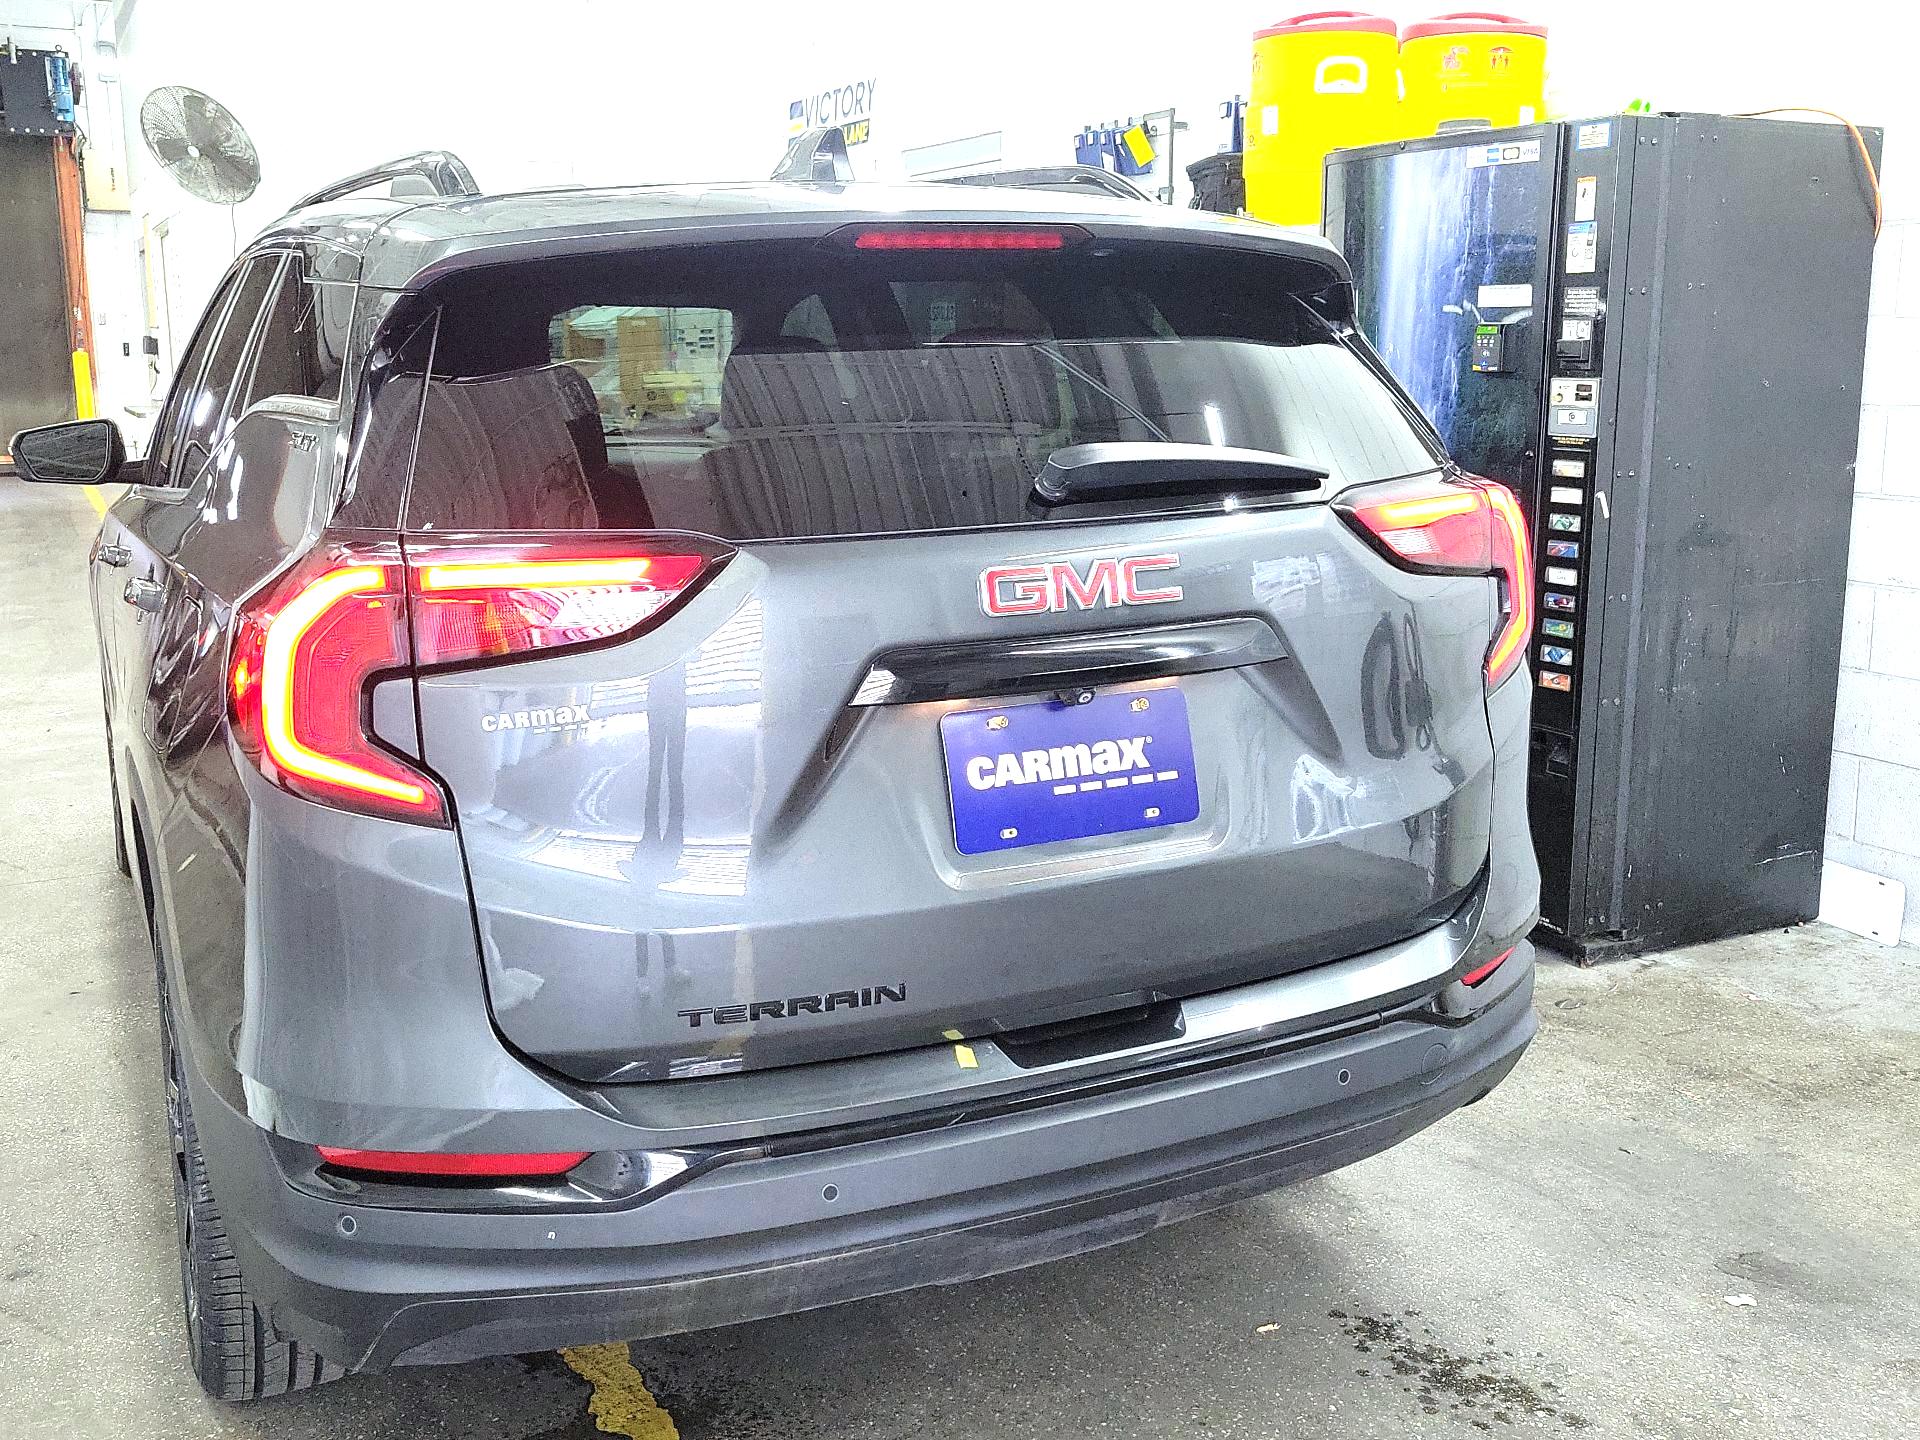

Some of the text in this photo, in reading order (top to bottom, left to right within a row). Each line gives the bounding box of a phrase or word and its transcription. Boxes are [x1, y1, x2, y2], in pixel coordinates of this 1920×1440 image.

[805, 78, 876, 127] VICTORY
[978, 553, 1184, 618] GMC
[678, 981, 906, 1028] TERRAIN
